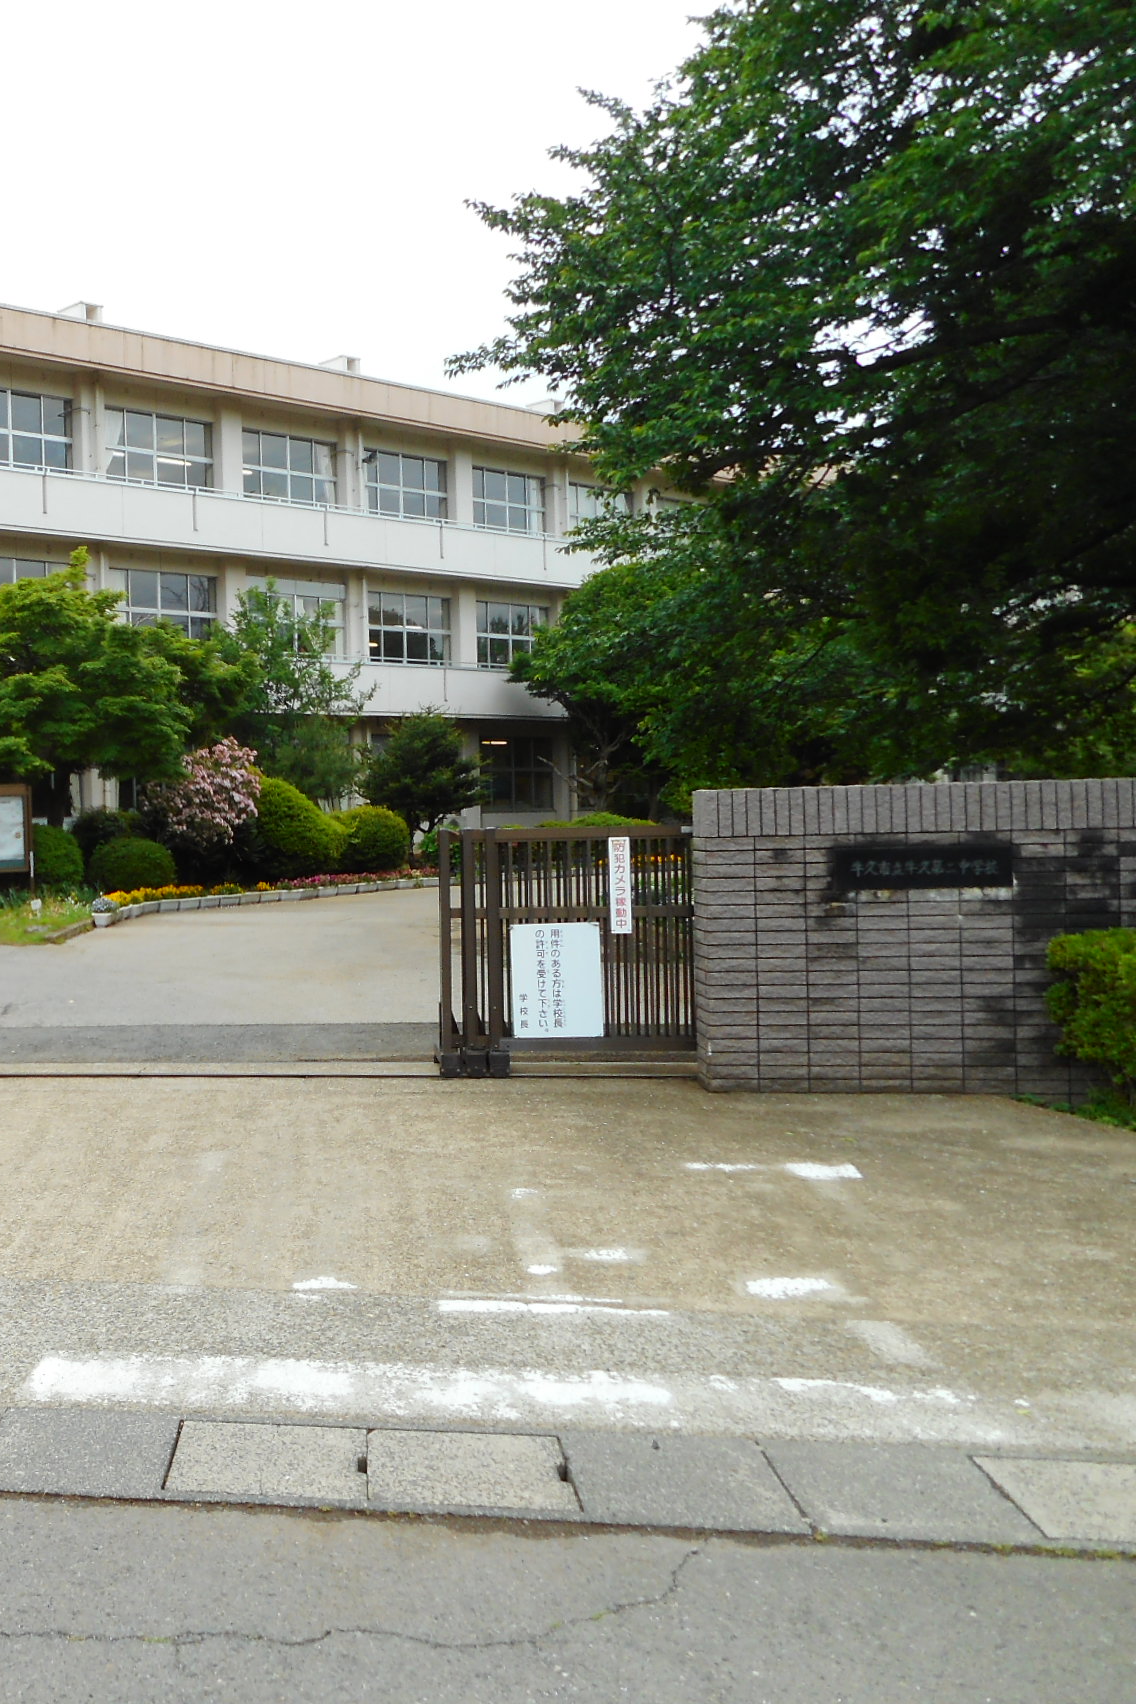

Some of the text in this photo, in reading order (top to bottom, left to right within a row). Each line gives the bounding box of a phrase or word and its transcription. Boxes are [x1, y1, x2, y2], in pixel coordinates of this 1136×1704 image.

[519, 993, 529, 1029] 学校長
[535, 930, 549, 1033] の許可を受けて下さい。
[551, 929, 563, 1028] 用件のある方は学校長
